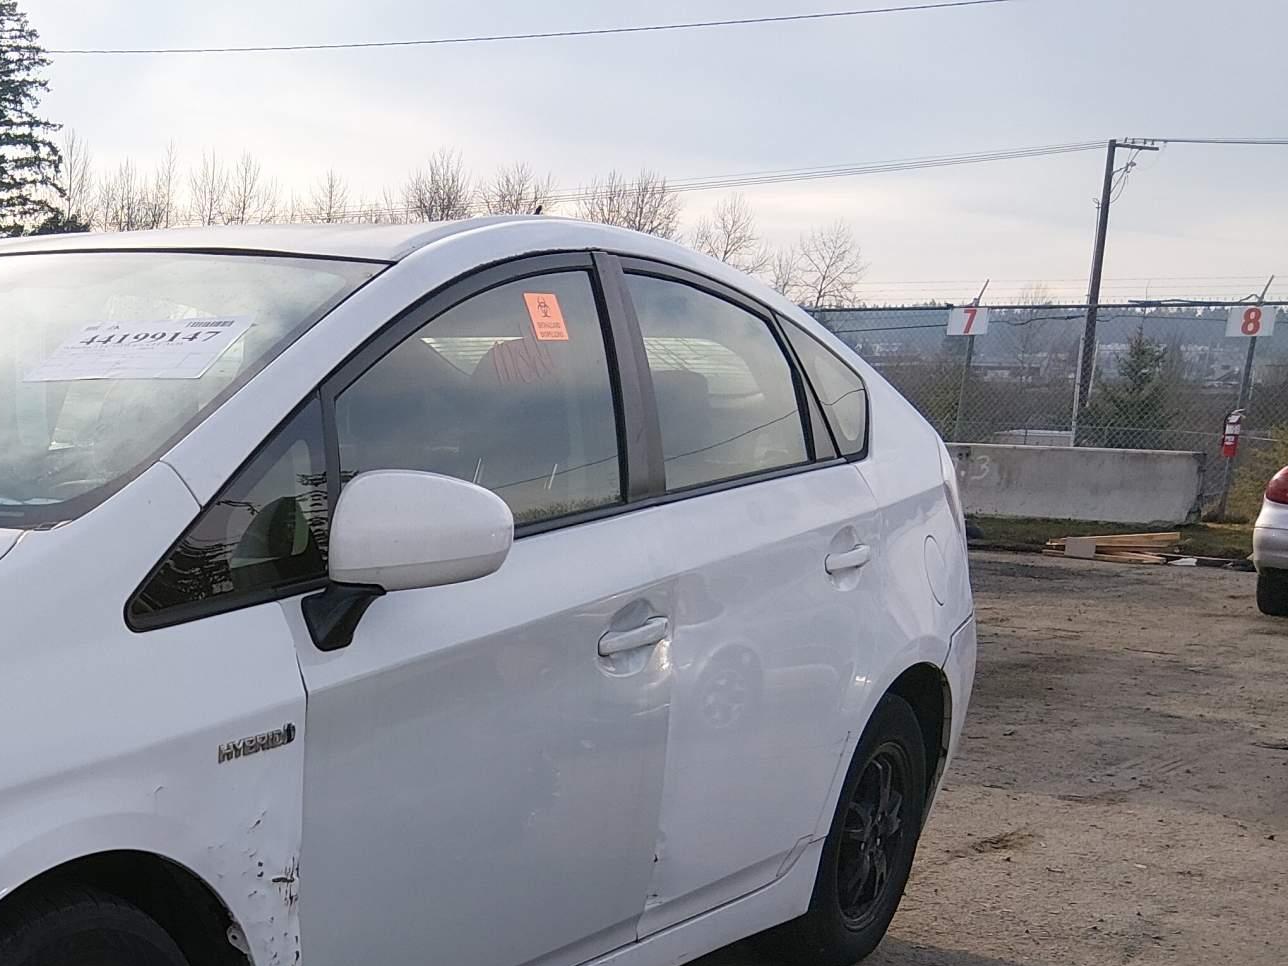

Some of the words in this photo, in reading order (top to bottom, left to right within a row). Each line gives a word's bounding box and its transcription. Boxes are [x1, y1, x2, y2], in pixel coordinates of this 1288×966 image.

[963, 308, 977, 334] 7
[1241, 307, 1262, 335] 8
[80, 331, 221, 345] 44199147
[218, 728, 284, 764] HYBRID
